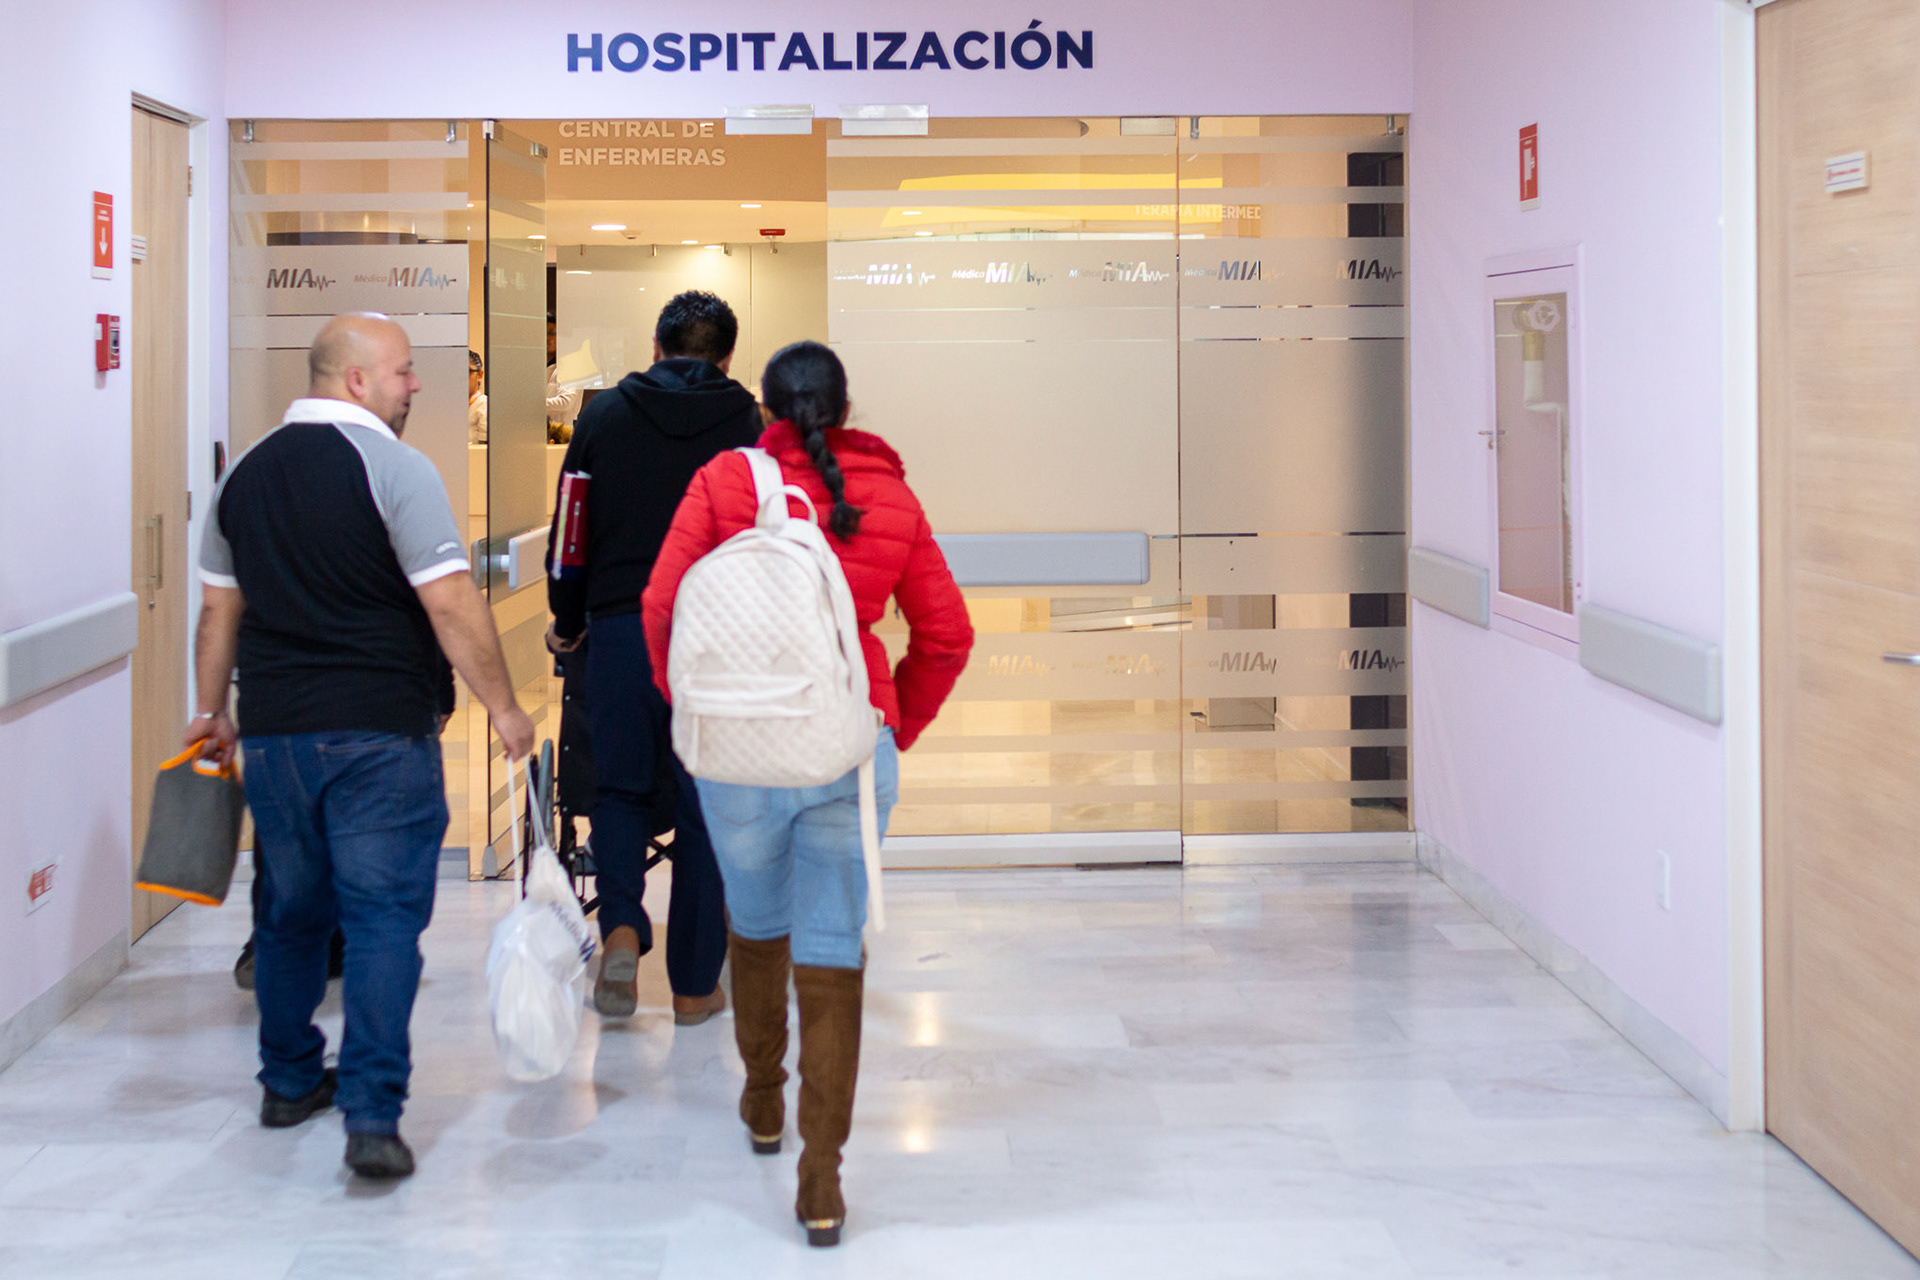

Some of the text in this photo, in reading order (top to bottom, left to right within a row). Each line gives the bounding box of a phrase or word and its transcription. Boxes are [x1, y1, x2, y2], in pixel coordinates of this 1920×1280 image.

[567, 19, 1093, 73] HOSPITALIZACIÓN
[558, 120, 714, 138] CENTRAL DE
[559, 148, 726, 166] ENFERMERAS
[1136, 204, 1193, 217] TERAPIA
[266, 268, 315, 289] MIA
[387, 267, 435, 287] MIA
[952, 262, 1031, 283] Médica MIA
[1218, 260, 1262, 281] MIA
[1335, 259, 1381, 280] MIA
[1220, 651, 1266, 672] MIA
[1337, 650, 1385, 670] MIA
